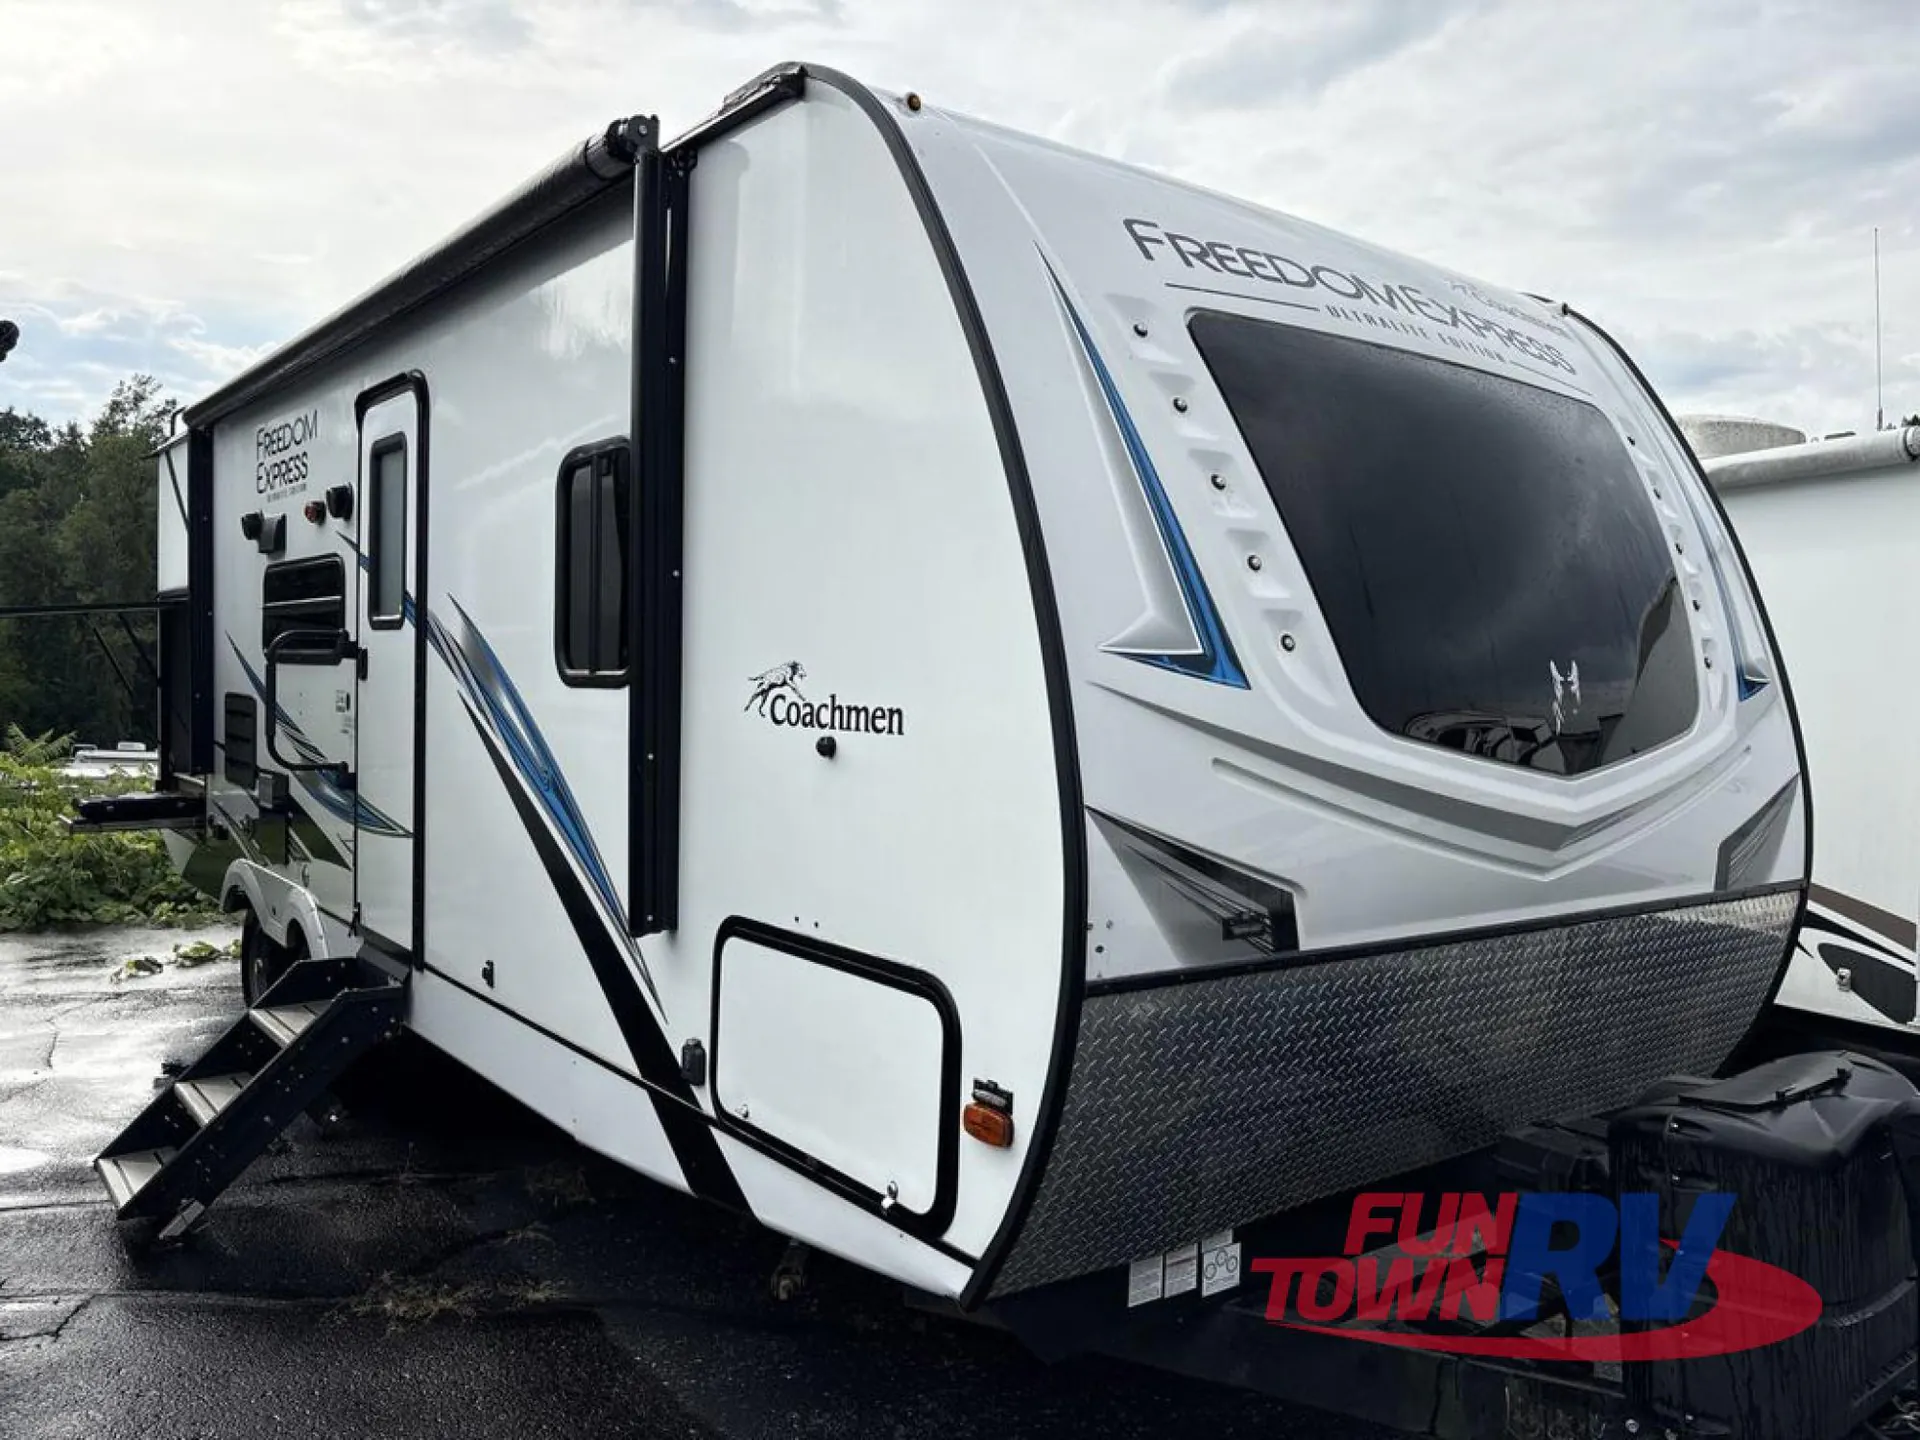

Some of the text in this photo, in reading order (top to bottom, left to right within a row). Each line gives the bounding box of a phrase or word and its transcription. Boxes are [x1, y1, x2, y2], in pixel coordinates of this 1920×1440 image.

[256, 409, 318, 461] FREEDOM
[256, 451, 308, 494] EXPRESS
[770, 693, 904, 735] Coachmen
